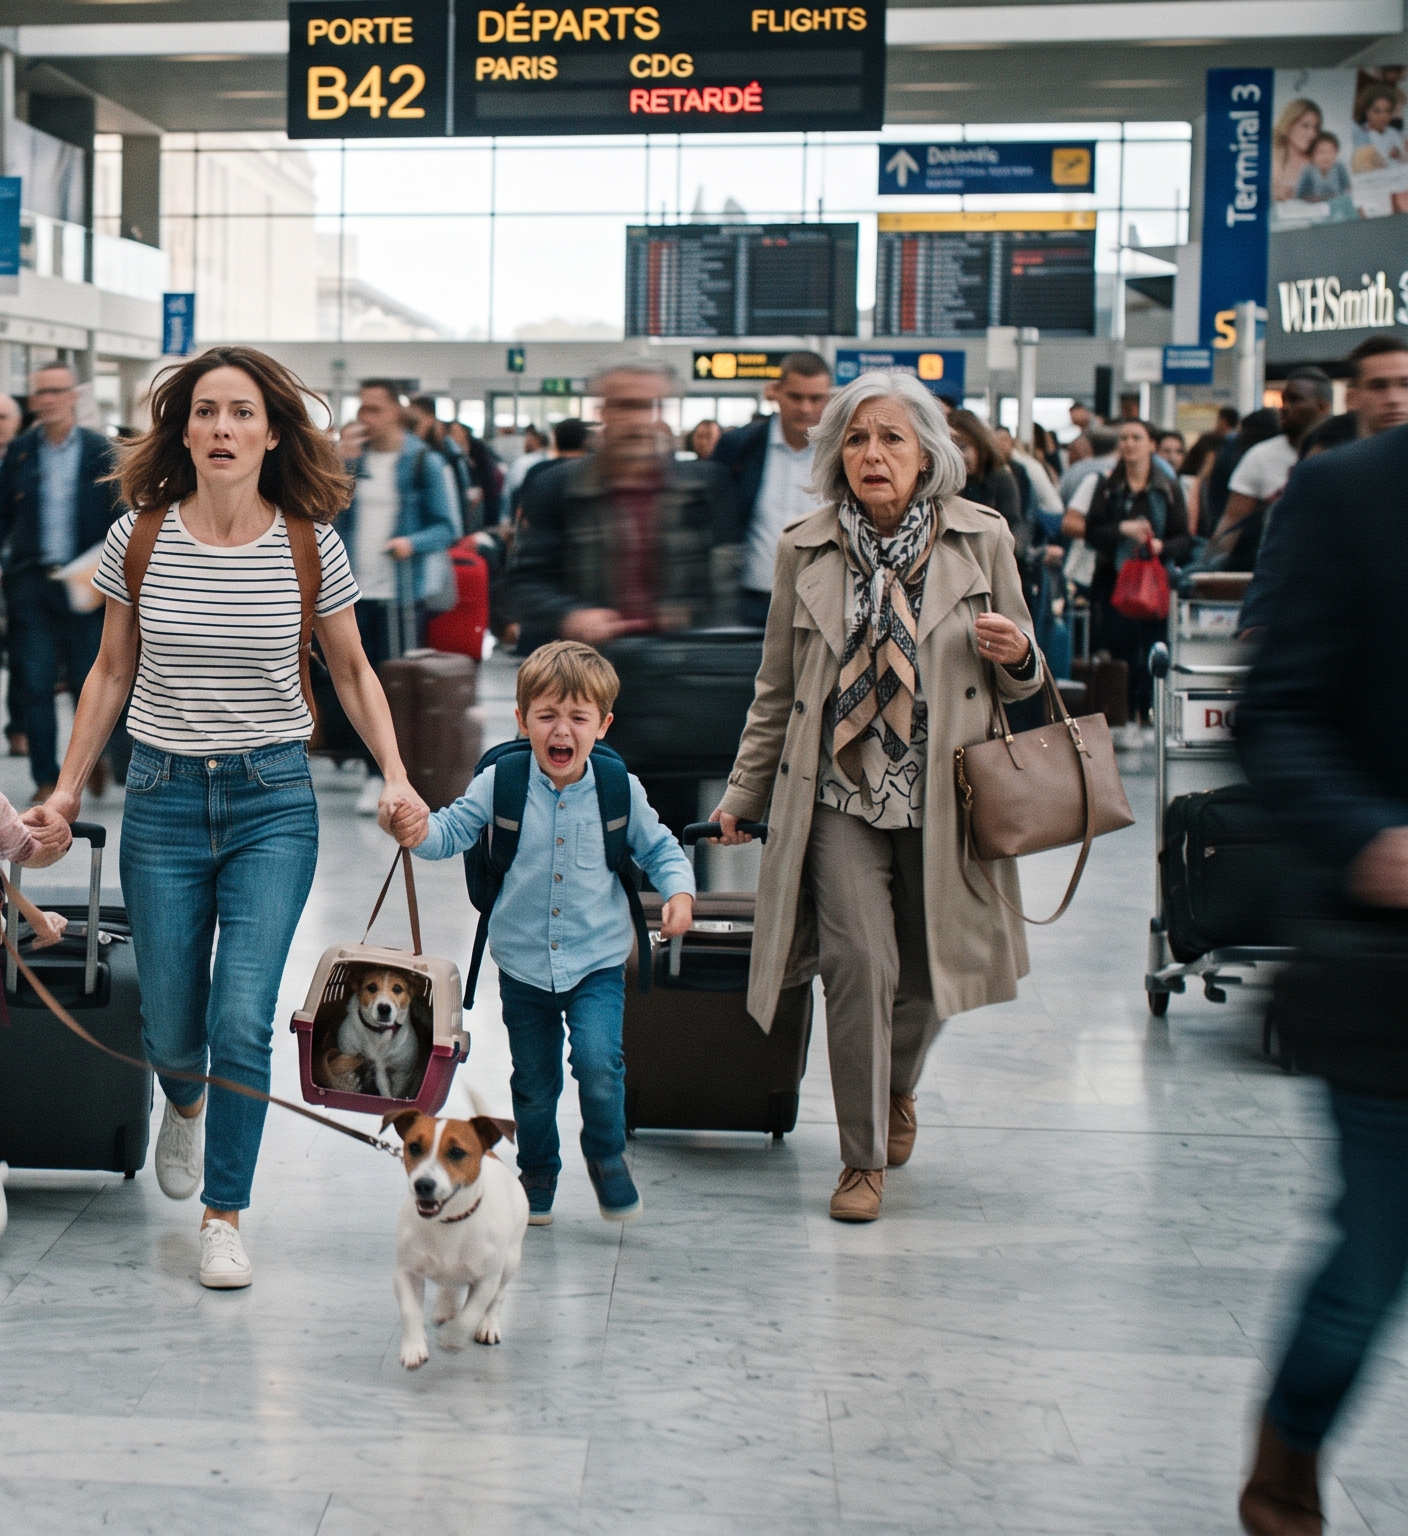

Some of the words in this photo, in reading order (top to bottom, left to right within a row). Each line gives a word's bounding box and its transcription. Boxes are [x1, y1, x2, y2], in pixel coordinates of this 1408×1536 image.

[307, 17, 414, 45] PORTE
[478, 3, 661, 42] DÉPARTS
[751, 7, 868, 33] FLIGHTS
[476, 56, 558, 81] PARIS
[630, 53, 694, 79] CDG
[307, 64, 426, 120] B42
[629, 82, 764, 113] RETARDÉ
[1231, 83, 1261, 102] 3
[1226, 111, 1260, 228] Terminal
[1277, 270, 1395, 334] WHSmith
